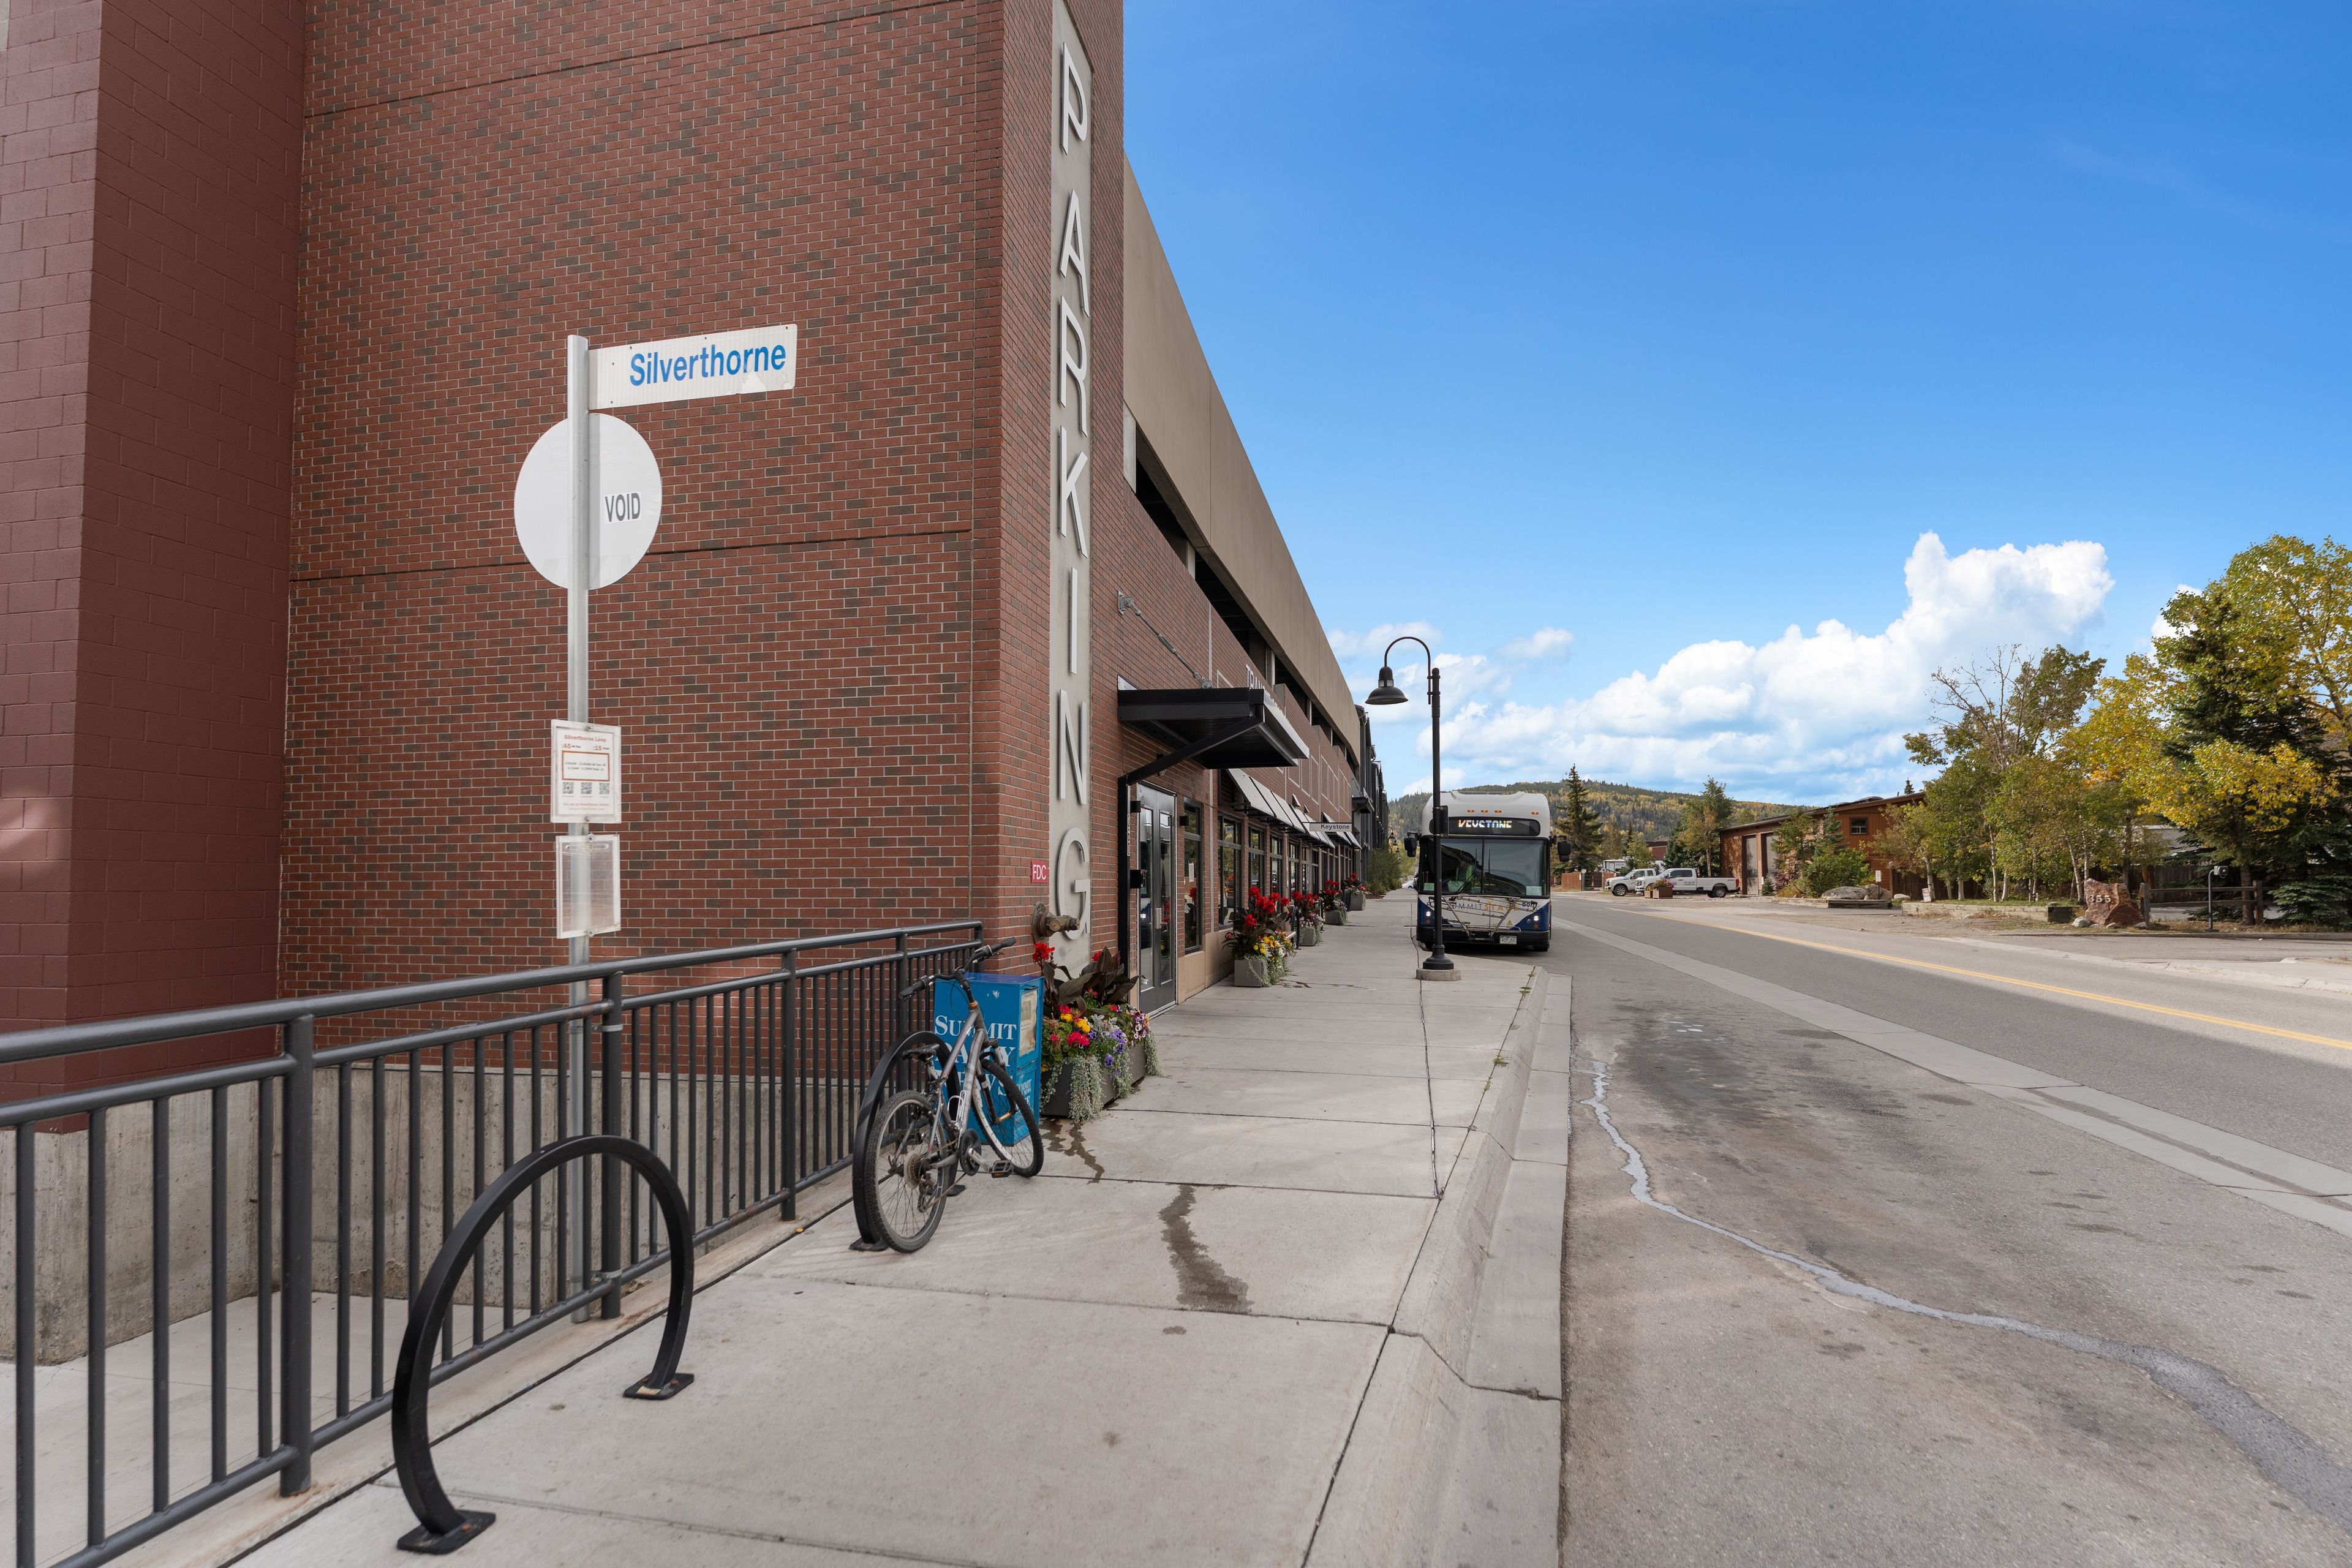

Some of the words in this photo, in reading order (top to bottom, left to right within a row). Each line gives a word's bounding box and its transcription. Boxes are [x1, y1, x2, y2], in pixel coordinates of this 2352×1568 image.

[630, 344, 786, 386] Silverthorne
[1057, 40, 1090, 940] PARKING
[605, 492, 641, 523] VOID
[1033, 864, 1047, 881] FDC
[2089, 894, 2111, 903] 355
[935, 1015, 1017, 1040] SUMIT
